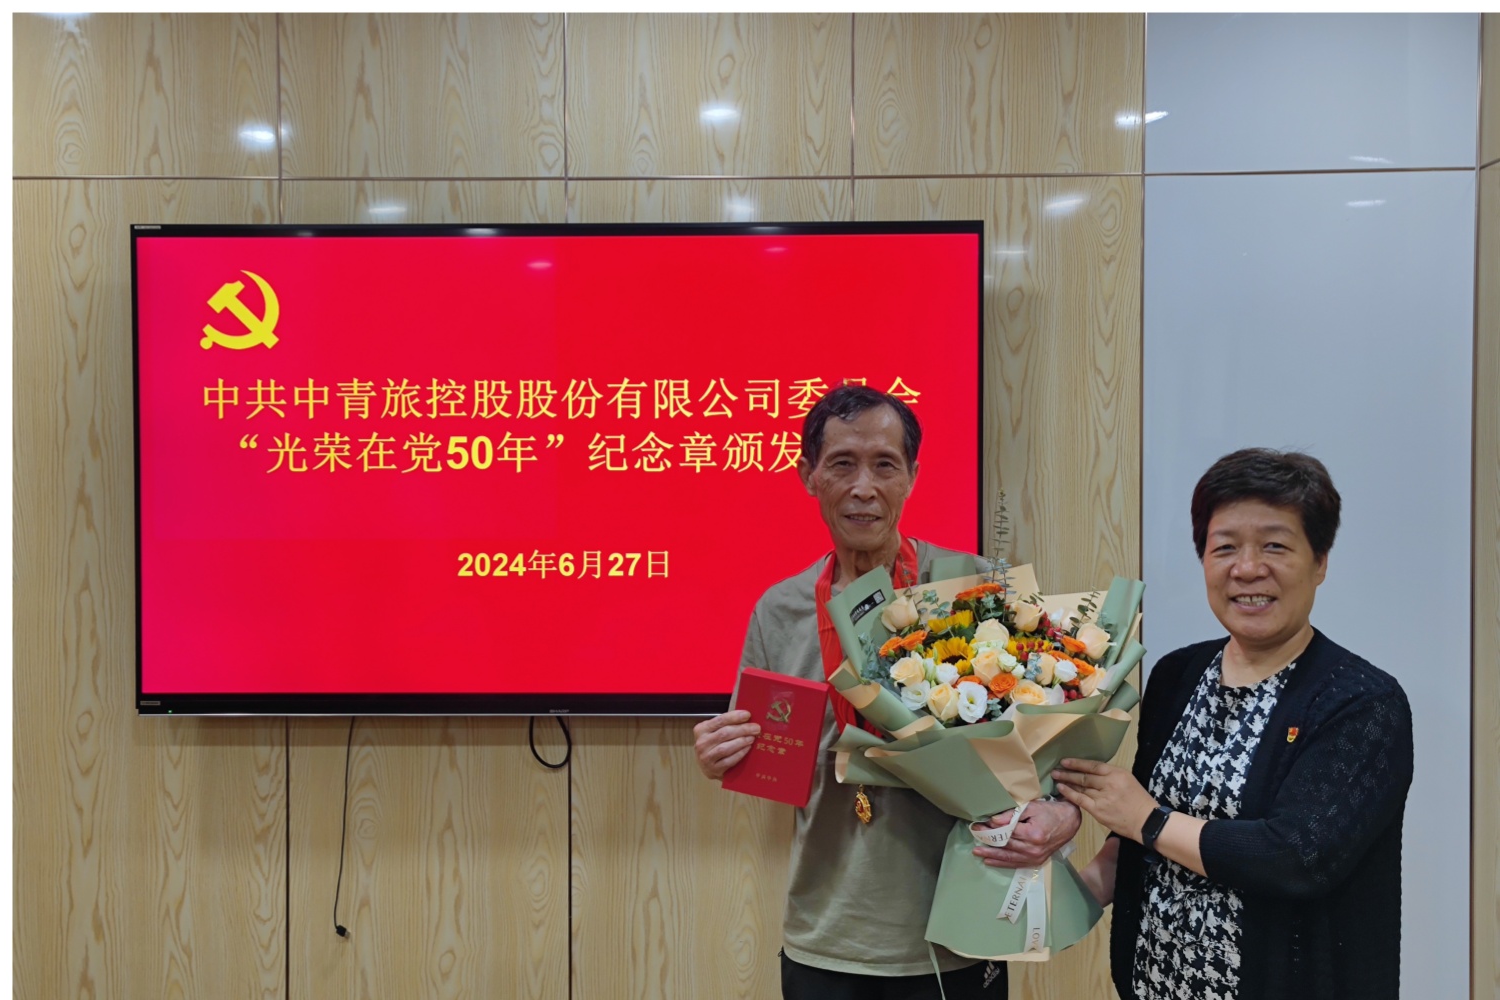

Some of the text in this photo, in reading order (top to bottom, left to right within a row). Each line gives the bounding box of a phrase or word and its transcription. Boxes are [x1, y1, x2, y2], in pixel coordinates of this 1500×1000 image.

[200, 376, 922, 422] 中共中青旅控股股份有限公司委会
[457, 549, 672, 580] 2024年6月27日
